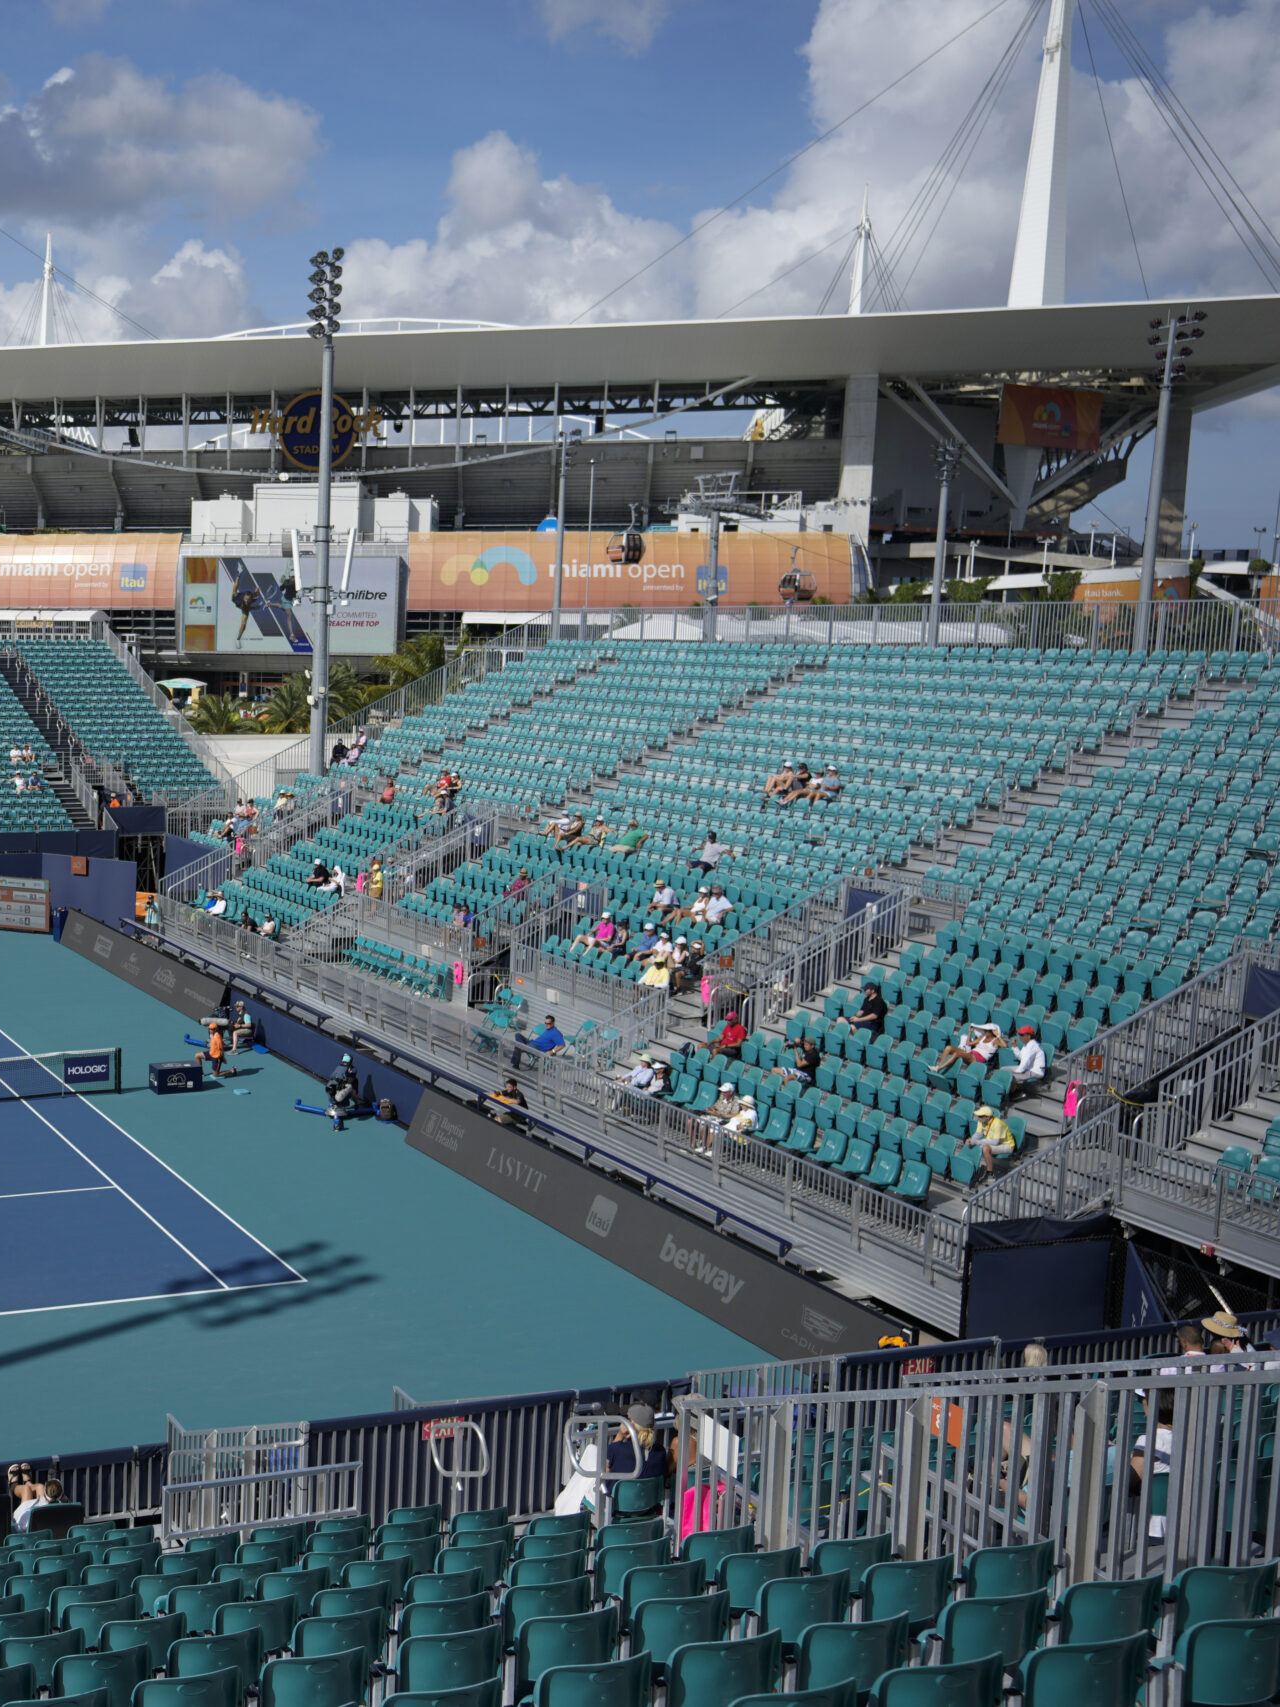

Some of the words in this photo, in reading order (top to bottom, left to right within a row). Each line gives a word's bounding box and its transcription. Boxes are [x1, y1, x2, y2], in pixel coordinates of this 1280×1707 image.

[250, 407, 317, 435] Hard
[293, 445, 340, 455] STADM
[0, 561, 58, 577] miami
[63, 562, 111, 580] open
[548, 560, 621, 578] miami
[628, 563, 685, 583] open
[121, 576, 145, 588] Itaú
[643, 583, 674, 592] presented
[675, 583, 684, 592] by
[698, 578, 726, 591] Itú
[1084, 588, 1100, 597] Itaú
[67, 1063, 108, 1076] HOLOGIC
[441, 1116, 465, 1139] Baptist
[435, 1130, 459, 1152] Health
[486, 1146, 548, 1193] LASVIT
[588, 1208, 615, 1233] Itaú
[659, 1234, 744, 1305] betway
[780, 1327, 824, 1356] CADIL
[908, 1357, 930, 1375] EXIT
